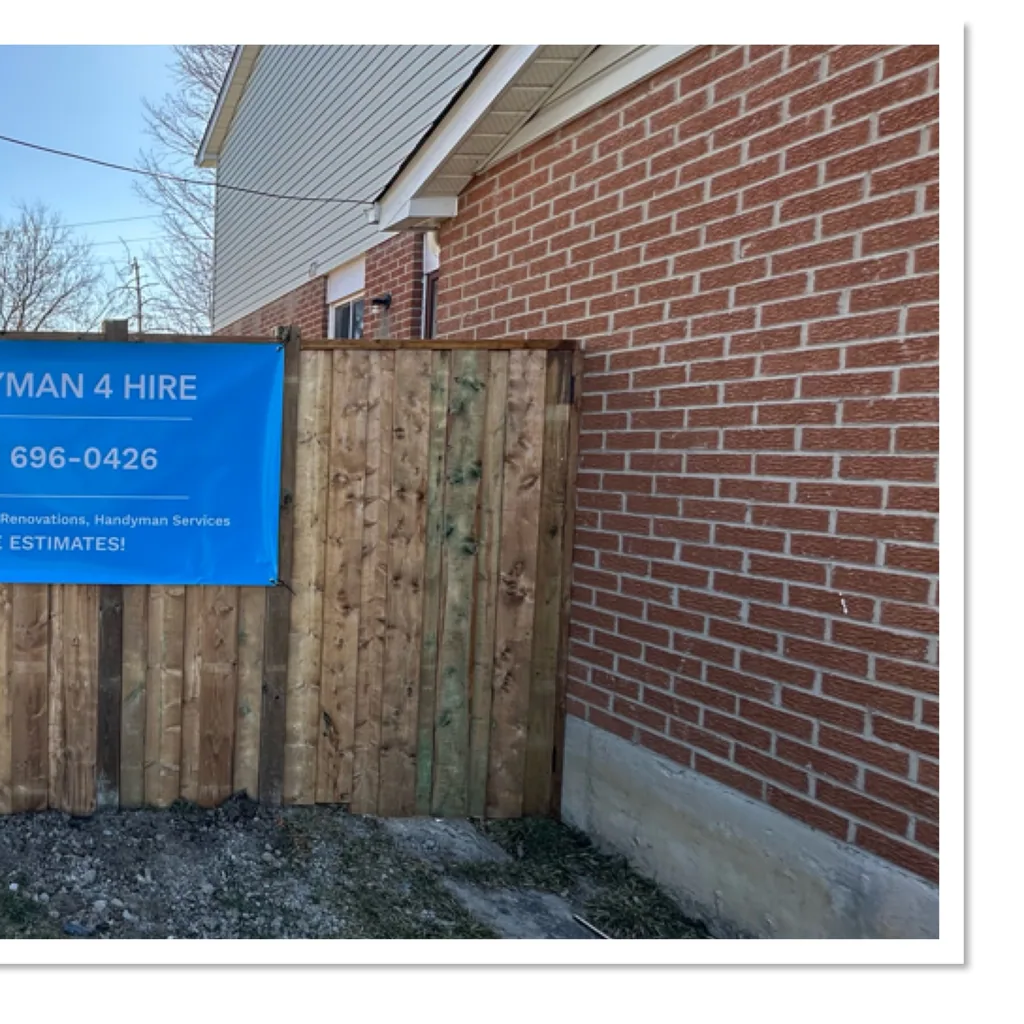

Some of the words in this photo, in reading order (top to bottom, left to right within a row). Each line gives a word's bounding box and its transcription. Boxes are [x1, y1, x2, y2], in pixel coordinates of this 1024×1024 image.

[94, 374, 113, 399] 4
[124, 374, 197, 401] HIRE
[10, 446, 158, 471] 696-0426
[0, 513, 90, 527] Renovations,
[94, 515, 168, 530] Handyman
[172, 515, 231, 527] Services
[10, 536, 126, 552] ESTIMATES!
